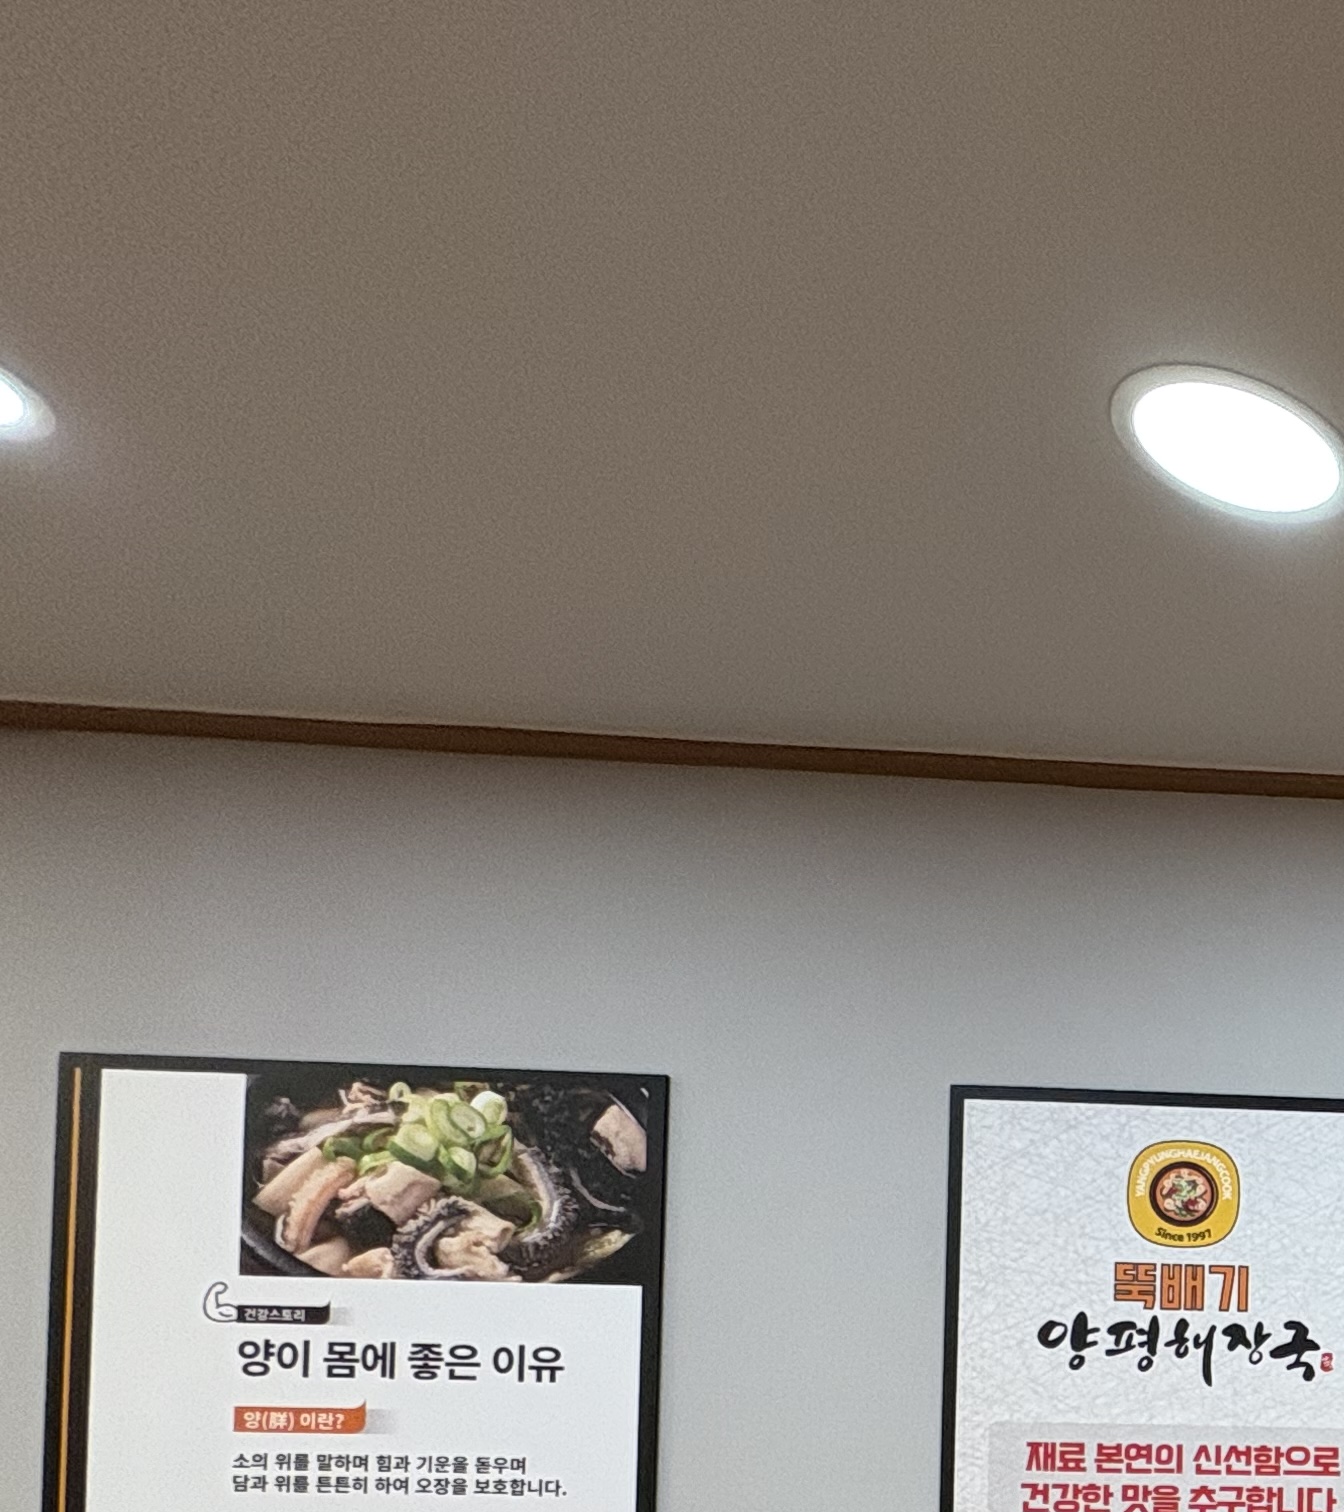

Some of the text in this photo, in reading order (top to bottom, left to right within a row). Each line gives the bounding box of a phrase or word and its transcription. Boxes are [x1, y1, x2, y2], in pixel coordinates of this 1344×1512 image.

[1154, 1227, 1212, 1242] Since 1997
[1113, 1261, 1250, 1313] 뚝배기
[243, 1307, 307, 1322] 건강스토리
[238, 1338, 565, 1383] 양이 몸에 좋은 이유
[1036, 1311, 1321, 1387] 양평해장국
[299, 1411, 345, 1431] 이란?
[231, 1452, 269, 1471] 소의
[274, 1452, 310, 1472] 위를
[316, 1453, 369, 1473] 말하며
[375, 1454, 411, 1473] 힘과
[416, 1455, 469, 1475] 기운을
[1025, 1441, 1341, 1477] 재료 본연의 신선함으로
[232, 1474, 567, 1498] 담과 위를 튼튼히 하여 오장을 보호합니다.
